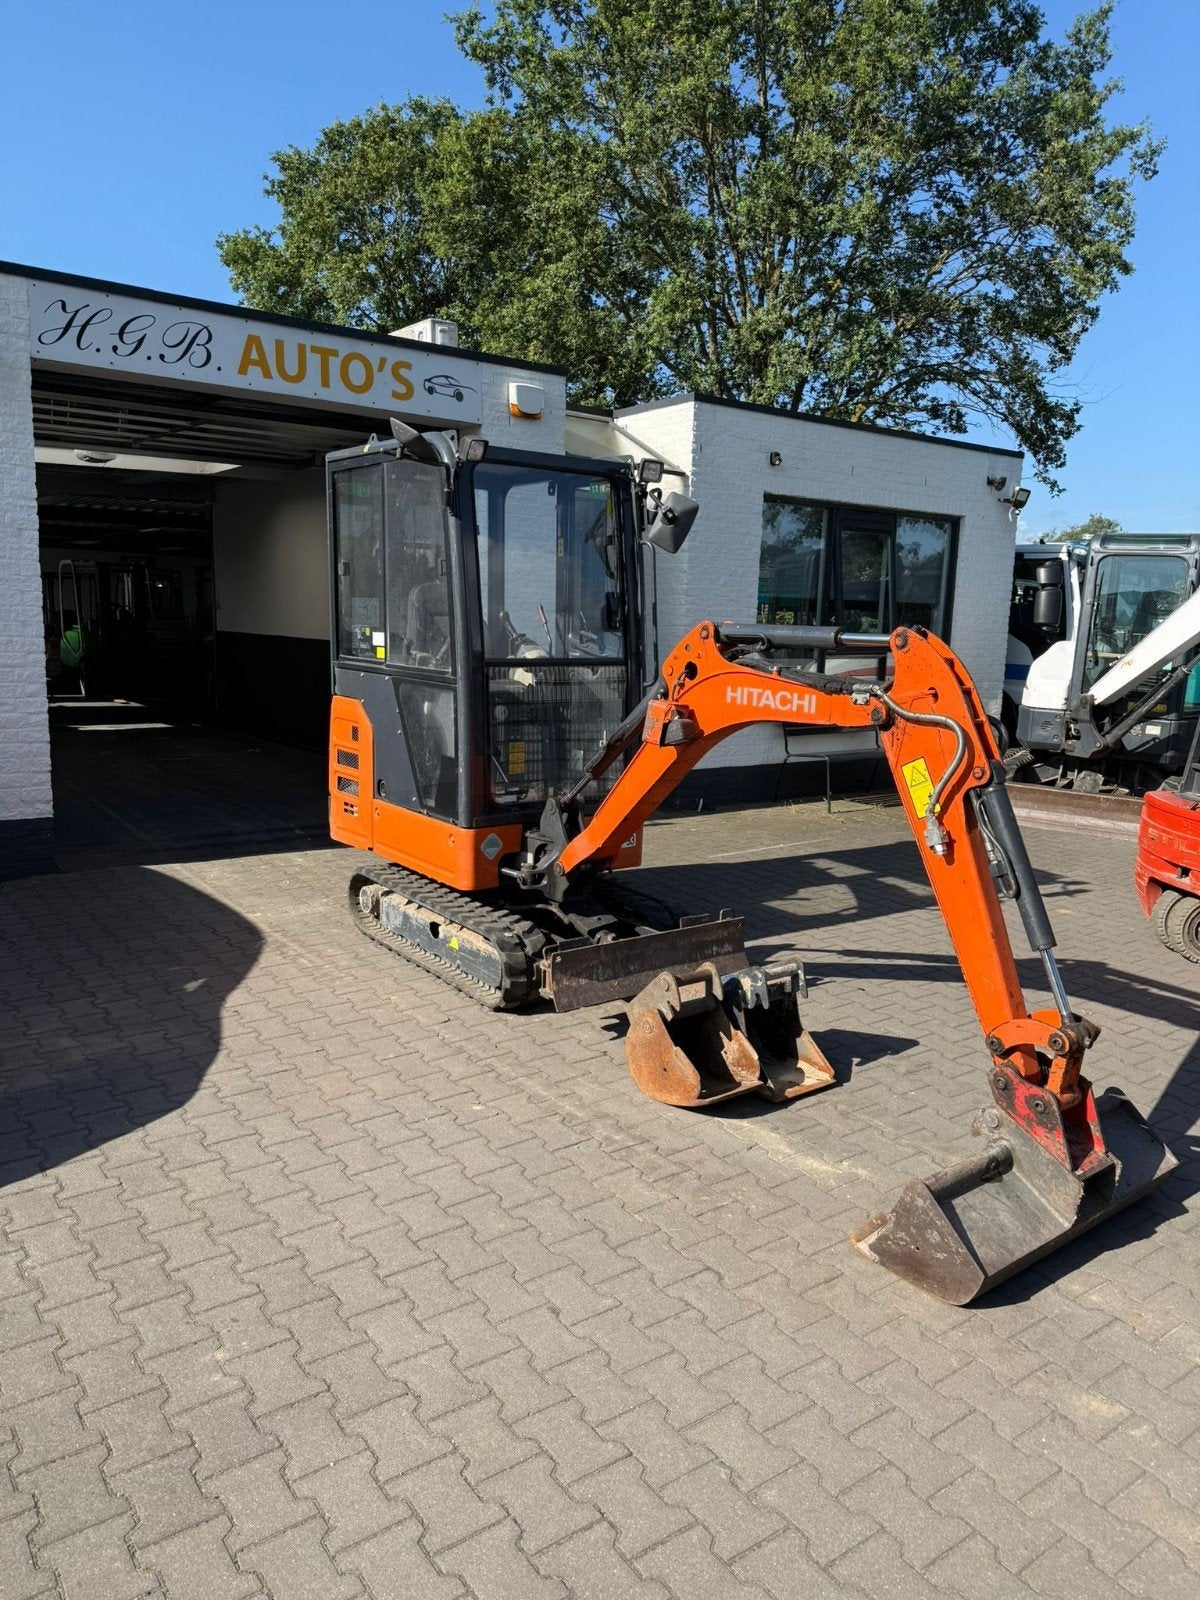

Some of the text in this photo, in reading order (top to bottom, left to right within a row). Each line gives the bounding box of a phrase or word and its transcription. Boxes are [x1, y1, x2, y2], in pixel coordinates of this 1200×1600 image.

[238, 334, 415, 401] AUTO'S
[726, 685, 817, 714] HITACHI
[1147, 827, 1200, 857] STIL
